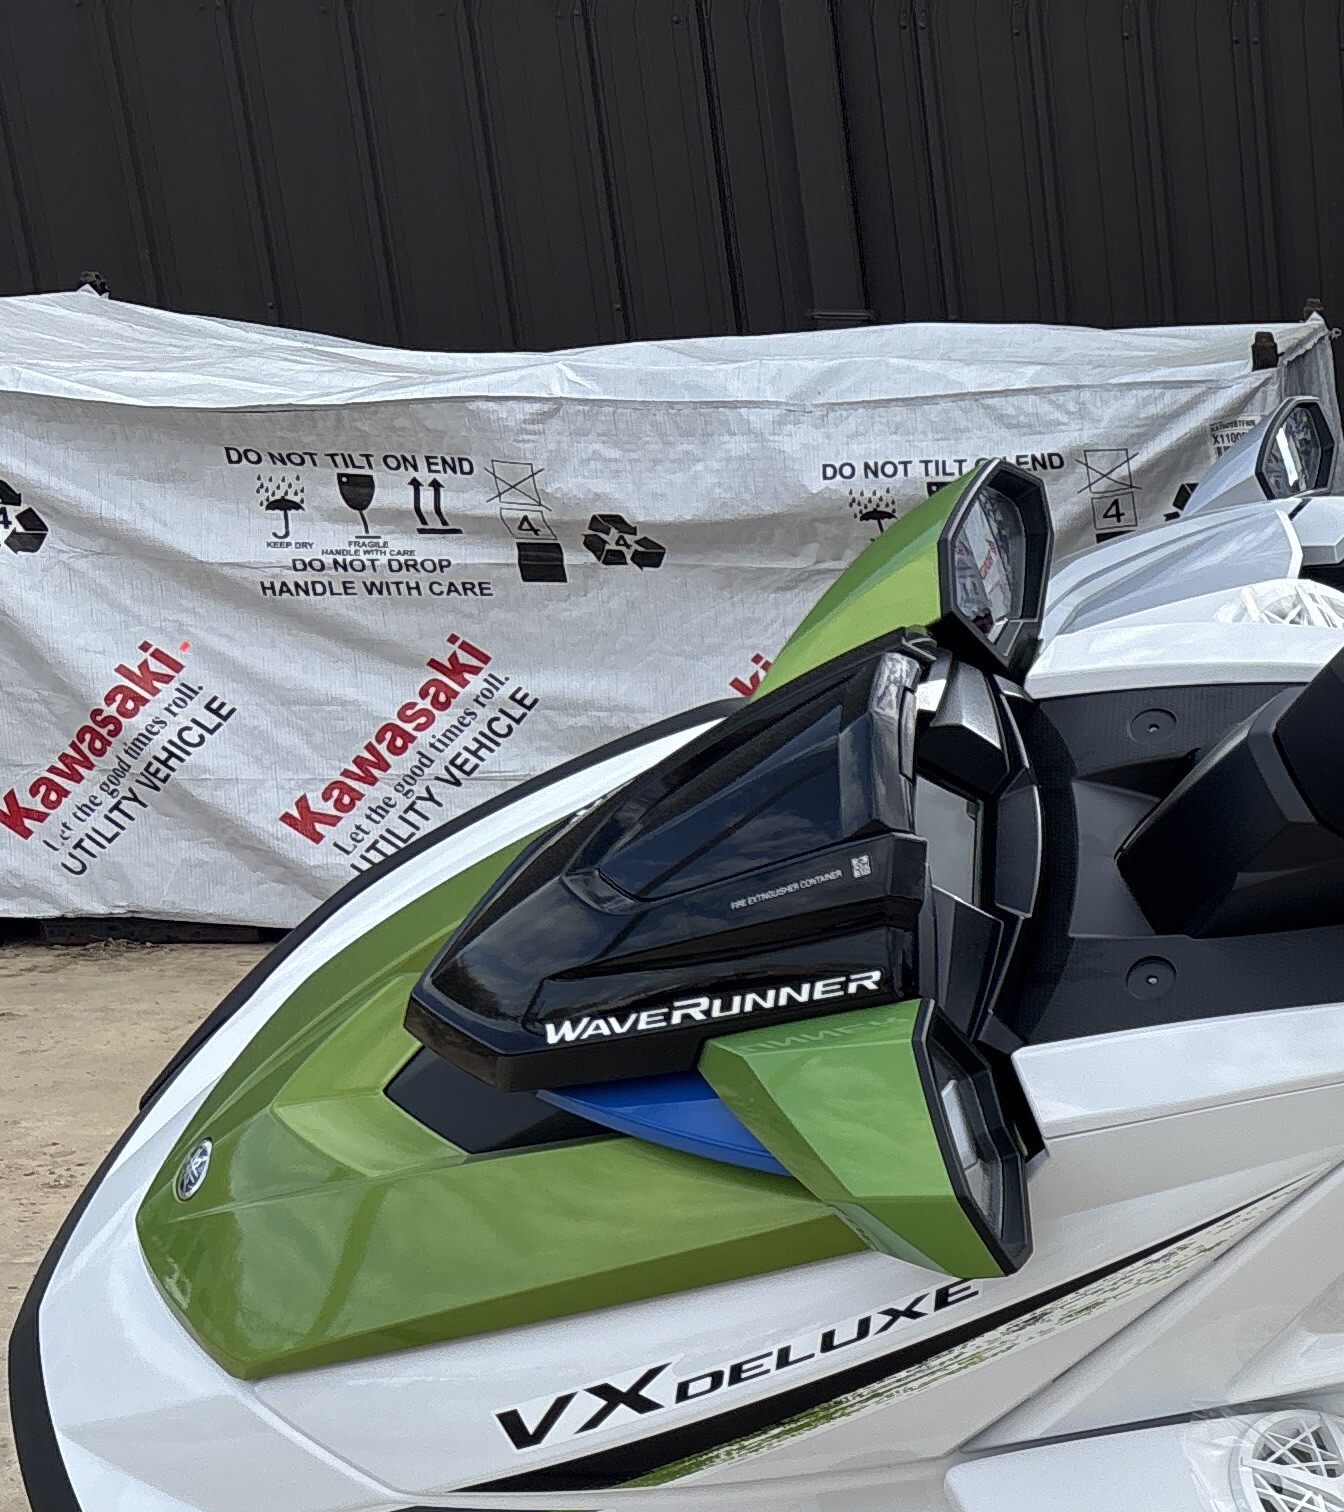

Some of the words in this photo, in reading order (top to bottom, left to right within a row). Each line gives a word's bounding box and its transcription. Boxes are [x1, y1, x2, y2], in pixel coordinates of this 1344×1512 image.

[224, 446, 262, 468] DO
[269, 451, 318, 470] NOT
[324, 452, 375, 472] TILT
[382, 454, 419, 474] ON
[427, 455, 475, 477] END
[821, 462, 856, 481] DO
[863, 460, 912, 479] NOT
[919, 459, 968, 477] TILT
[518, 514, 541, 534] 4
[1102, 498, 1125, 525] 4
[266, 541, 293, 549] KEEP
[294, 541, 315, 549] DRY
[348, 540, 389, 549] FRAGILE
[614, 533, 632, 550] 4
[291, 558, 326, 573] DO
[332, 558, 380, 573] NOT
[387, 558, 452, 574] DROP
[260, 580, 359, 597] HANDLE
[362, 580, 422, 597] WITH
[423, 580, 494, 597] CARE
[0, 640, 187, 841] Kawasaki
[278, 632, 493, 846] Kawasaki
[433, 686, 540, 789] VEHICLE
[72, 793, 104, 824] the
[99, 754, 133, 799] good
[124, 716, 169, 761] times
[163, 682, 204, 718] roll.
[332, 823, 372, 857] Let
[365, 795, 398, 826] the
[393, 750, 436, 799] good
[428, 706, 479, 754] times
[472, 672, 511, 710] roll.
[60, 786, 149, 876] UTILITY
[134, 694, 238, 793] VEHICLE
[496, 1363, 672, 1451] VX
[675, 1278, 981, 1404] DELUXE
